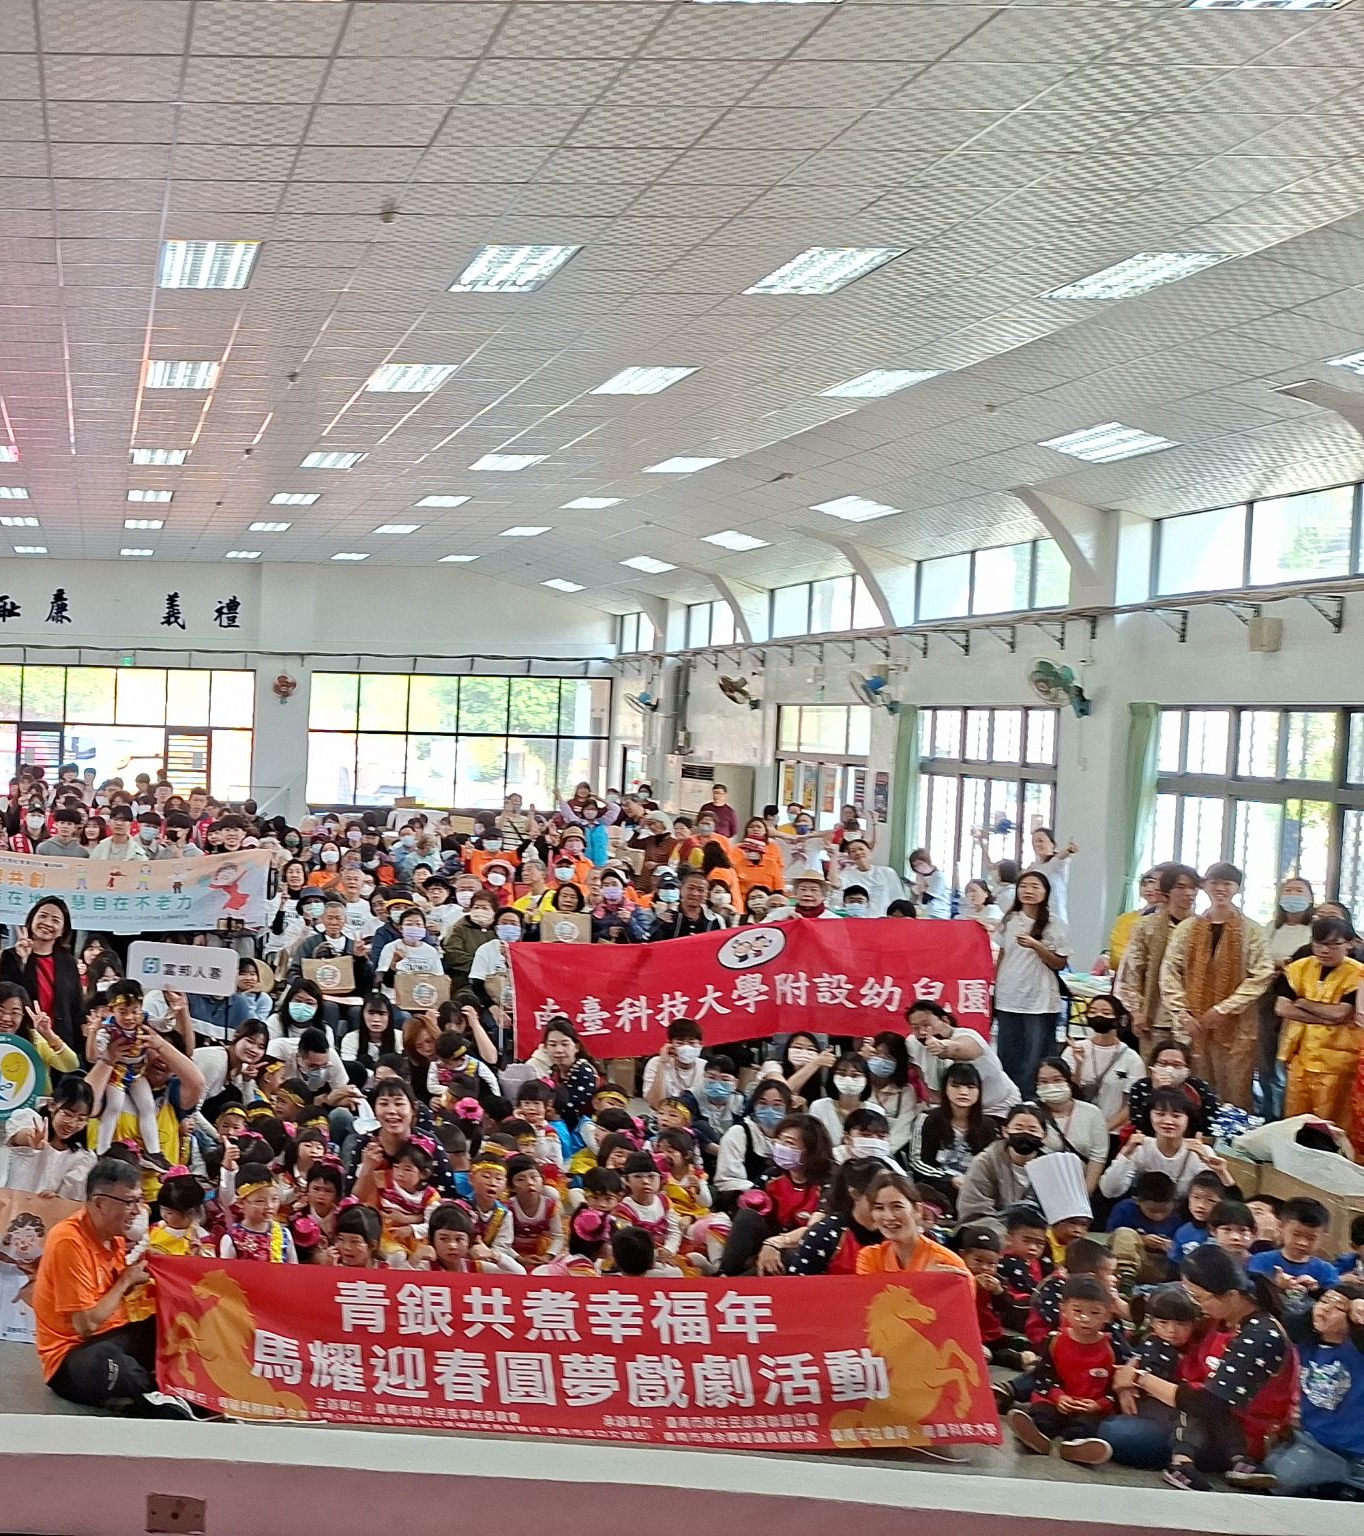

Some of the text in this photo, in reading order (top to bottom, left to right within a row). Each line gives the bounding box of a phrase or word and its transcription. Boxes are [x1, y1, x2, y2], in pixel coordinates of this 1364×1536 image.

[332, 1280, 777, 1346] 青銀共煮幸福年
[252, 1328, 890, 1408] 馬耀迎春圓夢戲劇活動
